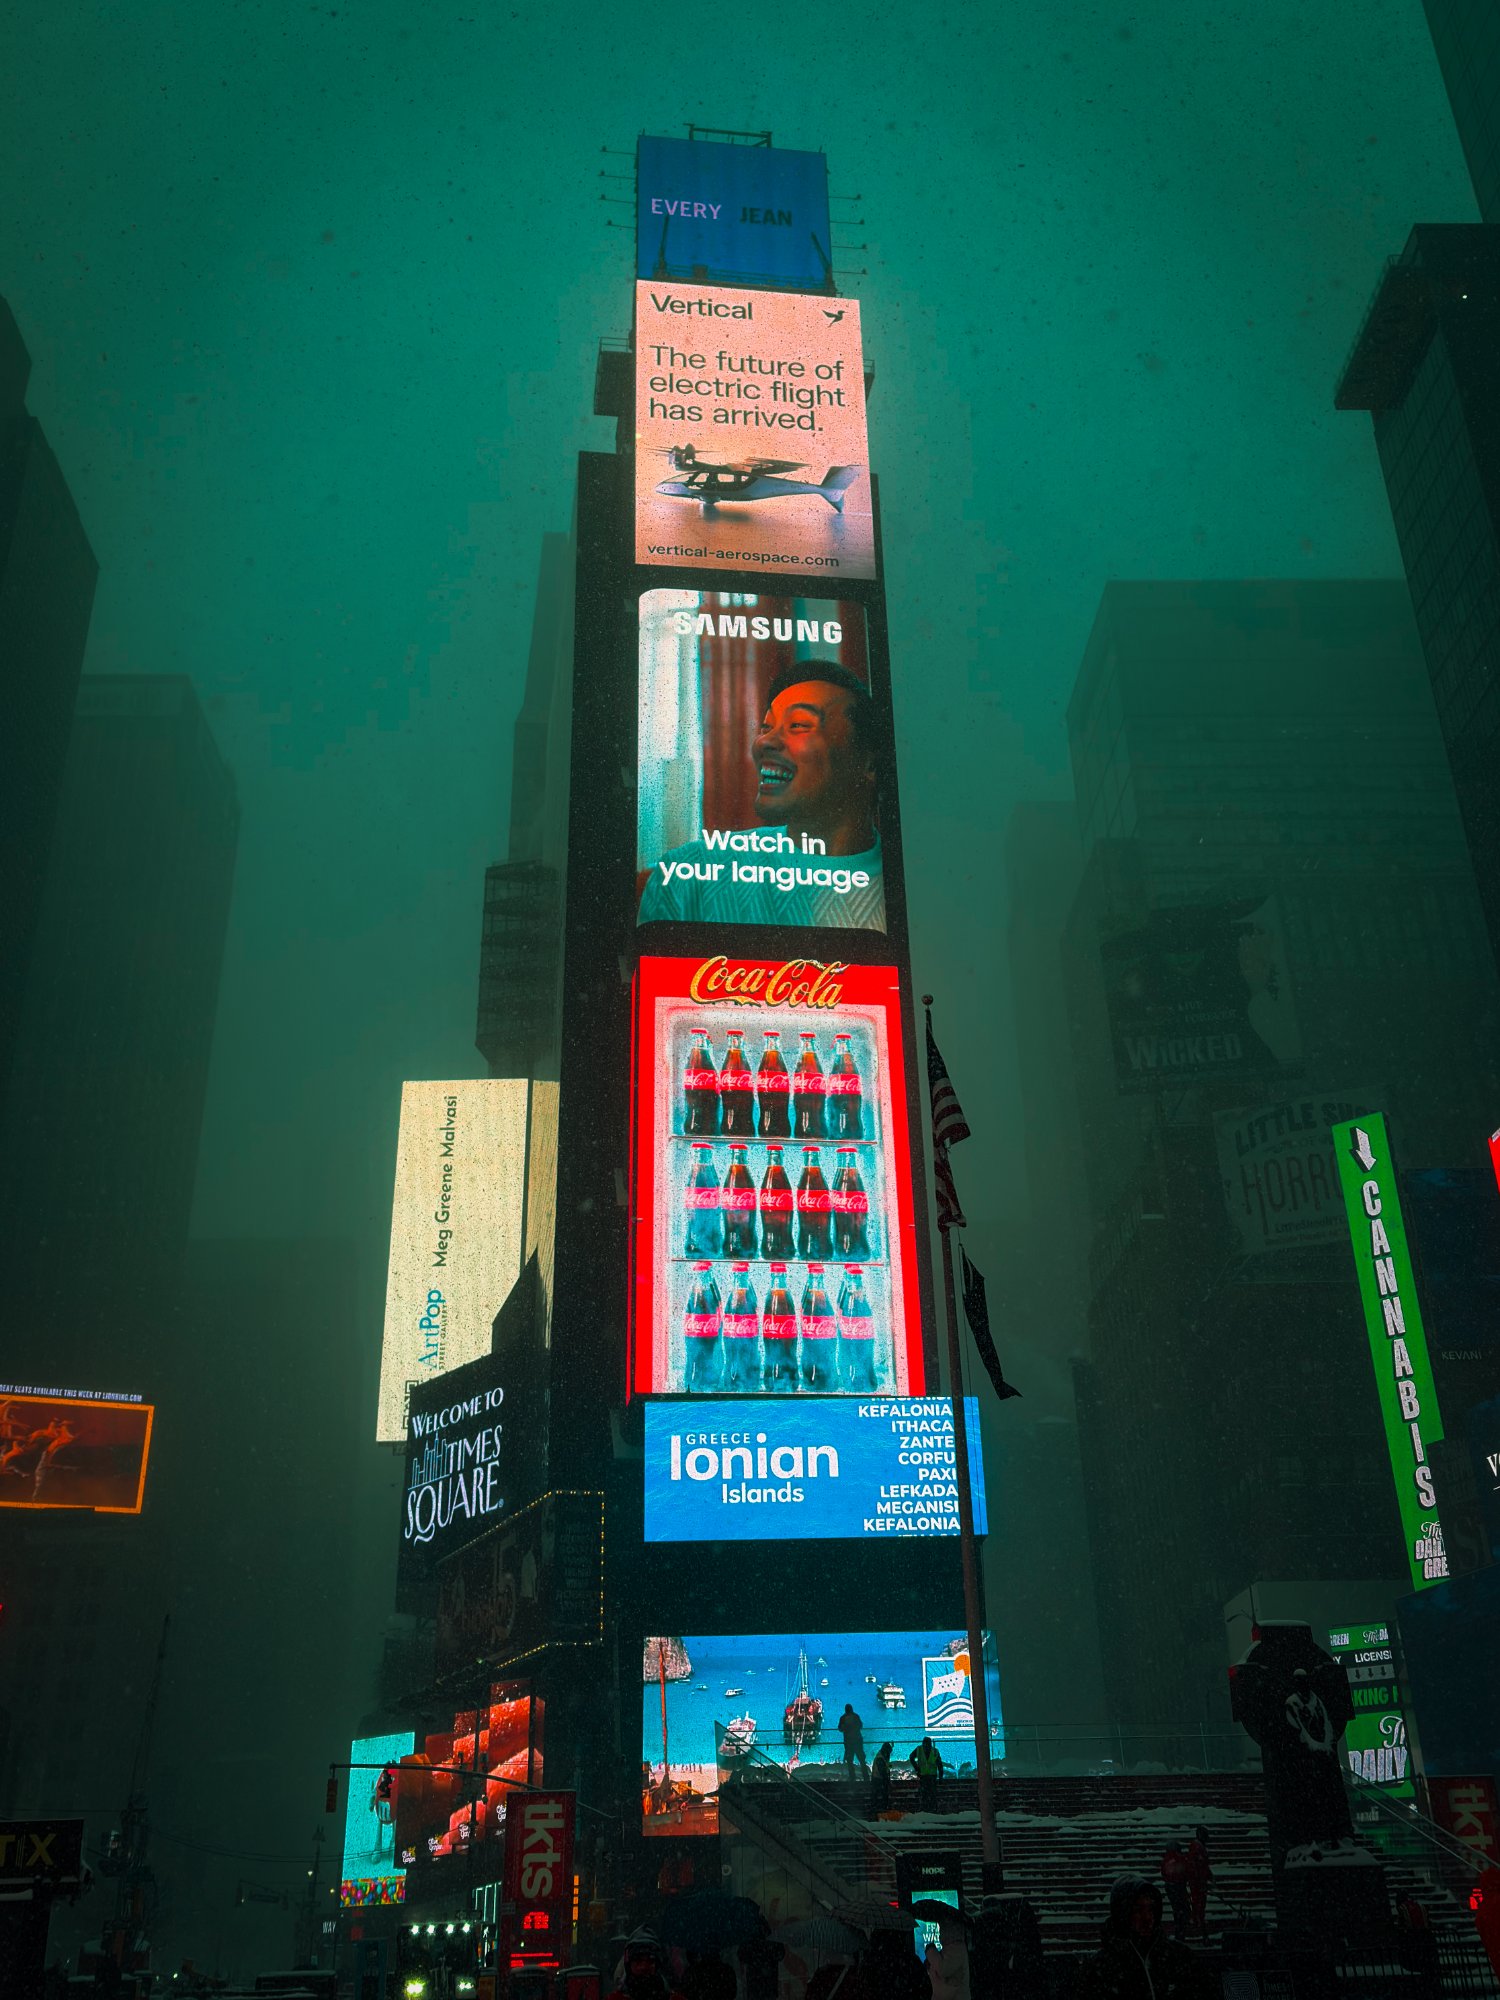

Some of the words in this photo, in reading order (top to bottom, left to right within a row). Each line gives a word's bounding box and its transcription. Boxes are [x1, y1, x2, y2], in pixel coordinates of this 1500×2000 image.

[651, 198, 722, 220] EVERY
[739, 206, 793, 227] JEAN
[651, 293, 753, 320] Vertical
[649, 345, 706, 369] The
[716, 350, 805, 378] future
[815, 360, 844, 381] of
[649, 373, 761, 400] electric
[771, 380, 846, 410] flight
[650, 397, 702, 422] has
[713, 405, 824, 432] arrived.
[647, 544, 840, 568] vertical-aerospace.com
[673, 611, 842, 645] SAMSUNG
[702, 828, 796, 854] Watch
[801, 832, 826, 856] in
[659, 860, 725, 886] your
[732, 860, 870, 894] language
[438, 1094, 458, 1158] Malvasi
[1234, 1102, 1318, 1158] LITTLE
[434, 1164, 453, 1223] Greene
[432, 1229, 453, 1267] Meg
[417, 1288, 446, 1371] ArtPop
[1361, 1178, 1437, 1508] CANNABIS
[438, 1342, 446, 1370] STREET
[411, 1395, 482, 1439] WELCOME
[484, 1387, 504, 1410] TO
[858, 1403, 953, 1418] KEFALONIA
[685, 1432, 751, 1445] GREECE
[891, 1418, 954, 1433] ITHACA
[447, 1425, 503, 1475] TIMES
[899, 1434, 955, 1449] ZANTE
[670, 1432, 839, 1481] Ionian
[898, 1450, 956, 1466] CORFU
[918, 1467, 957, 1481] PAXI
[404, 1460, 500, 1547] SQUARE
[722, 1481, 805, 1504] Islands
[880, 1483, 959, 1498] LEFKADA
[876, 1499, 960, 1515] MEGANISI
[863, 1516, 961, 1532] KEFALONIA
[1424, 1556, 1450, 1580] GRE
[1354, 1650, 1393, 1664] LICENS
[1353, 1686, 1389, 1706] KING
[1347, 1745, 1408, 1785] DAILY
[521, 1800, 565, 1899] tkts
